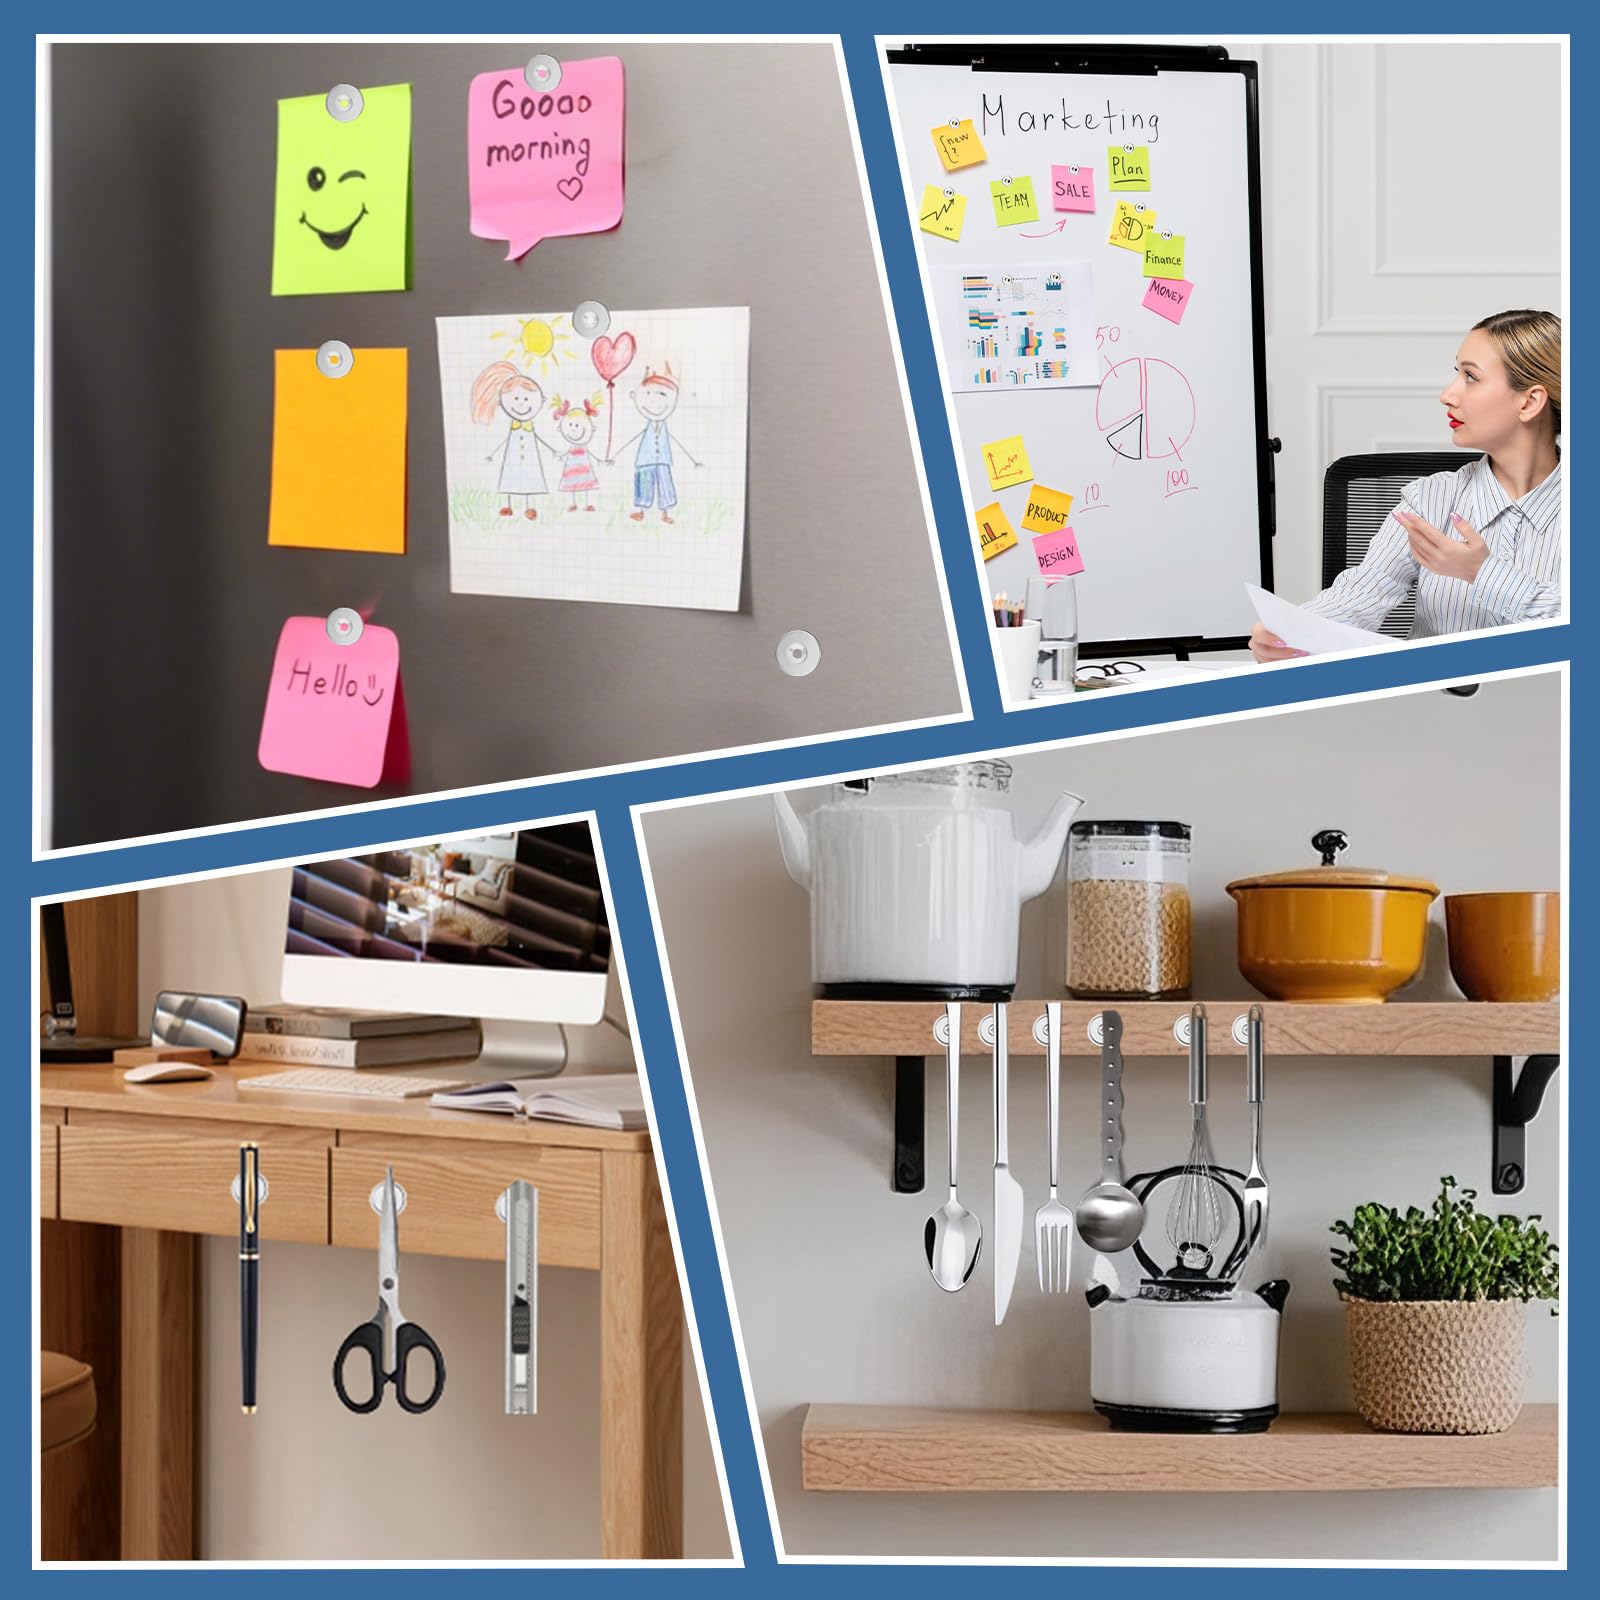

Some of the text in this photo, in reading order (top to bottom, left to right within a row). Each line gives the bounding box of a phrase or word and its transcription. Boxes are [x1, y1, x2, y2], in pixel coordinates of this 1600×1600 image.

[982, 93, 1160, 143] Marketing
[946, 133, 969, 145] new
[486, 131, 591, 176] morning
[1112, 156, 1144, 176] Plan
[1054, 181, 1091, 198] SALE
[993, 192, 1030, 211] TEAM
[1145, 250, 1182, 266] Finance
[1149, 279, 1184, 304] MONEY
[1096, 325, 1121, 351] 50
[1166, 469, 1189, 493] 100
[1085, 483, 1100, 505] 10
[1026, 502, 1069, 525] PRODUCT
[287, 658, 359, 697] Hello
